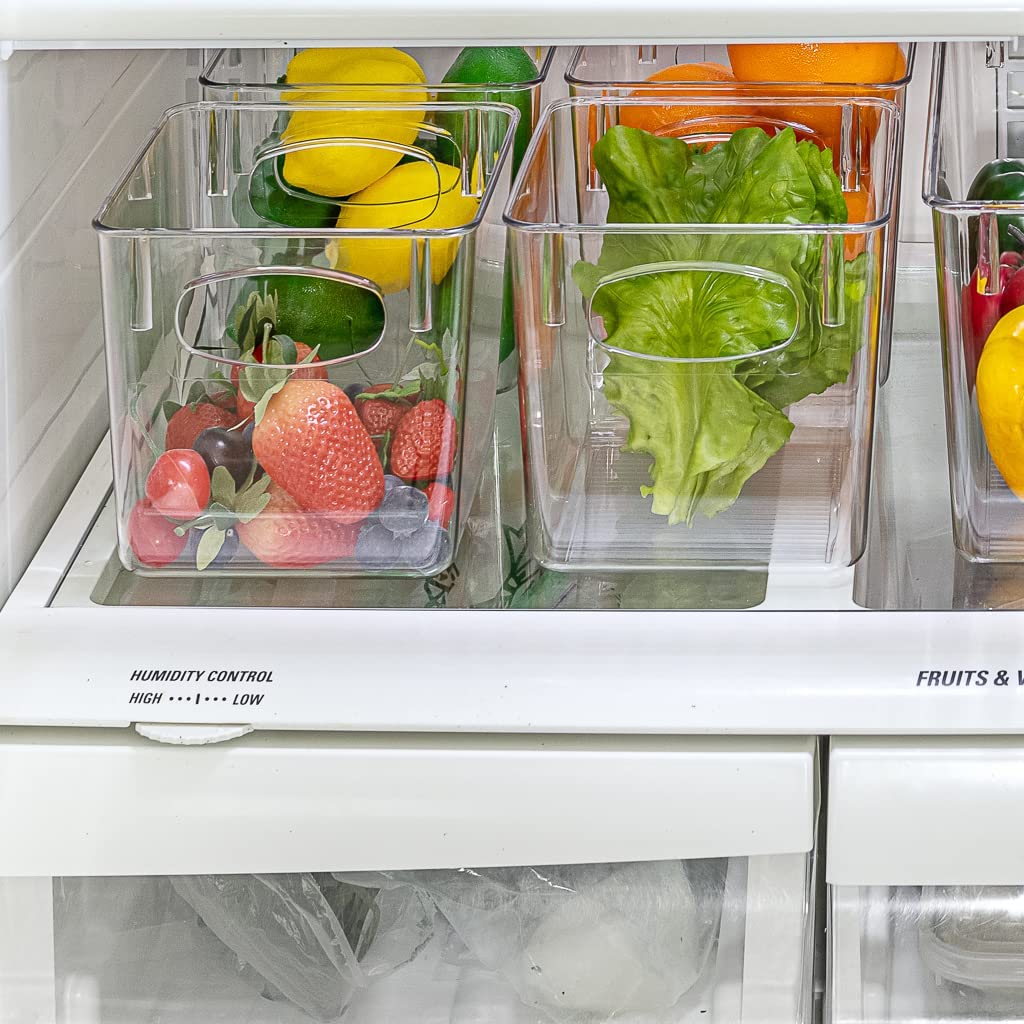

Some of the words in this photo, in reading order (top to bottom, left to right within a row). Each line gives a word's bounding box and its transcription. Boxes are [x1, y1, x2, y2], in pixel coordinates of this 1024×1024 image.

[130, 670, 206, 682] HUMIDITY
[207, 670, 274, 682] CONTROL
[916, 670, 989, 687] FRUITS
[993, 669, 1010, 686] &
[129, 692, 163, 704] HIGH
[232, 694, 265, 705] LOW
